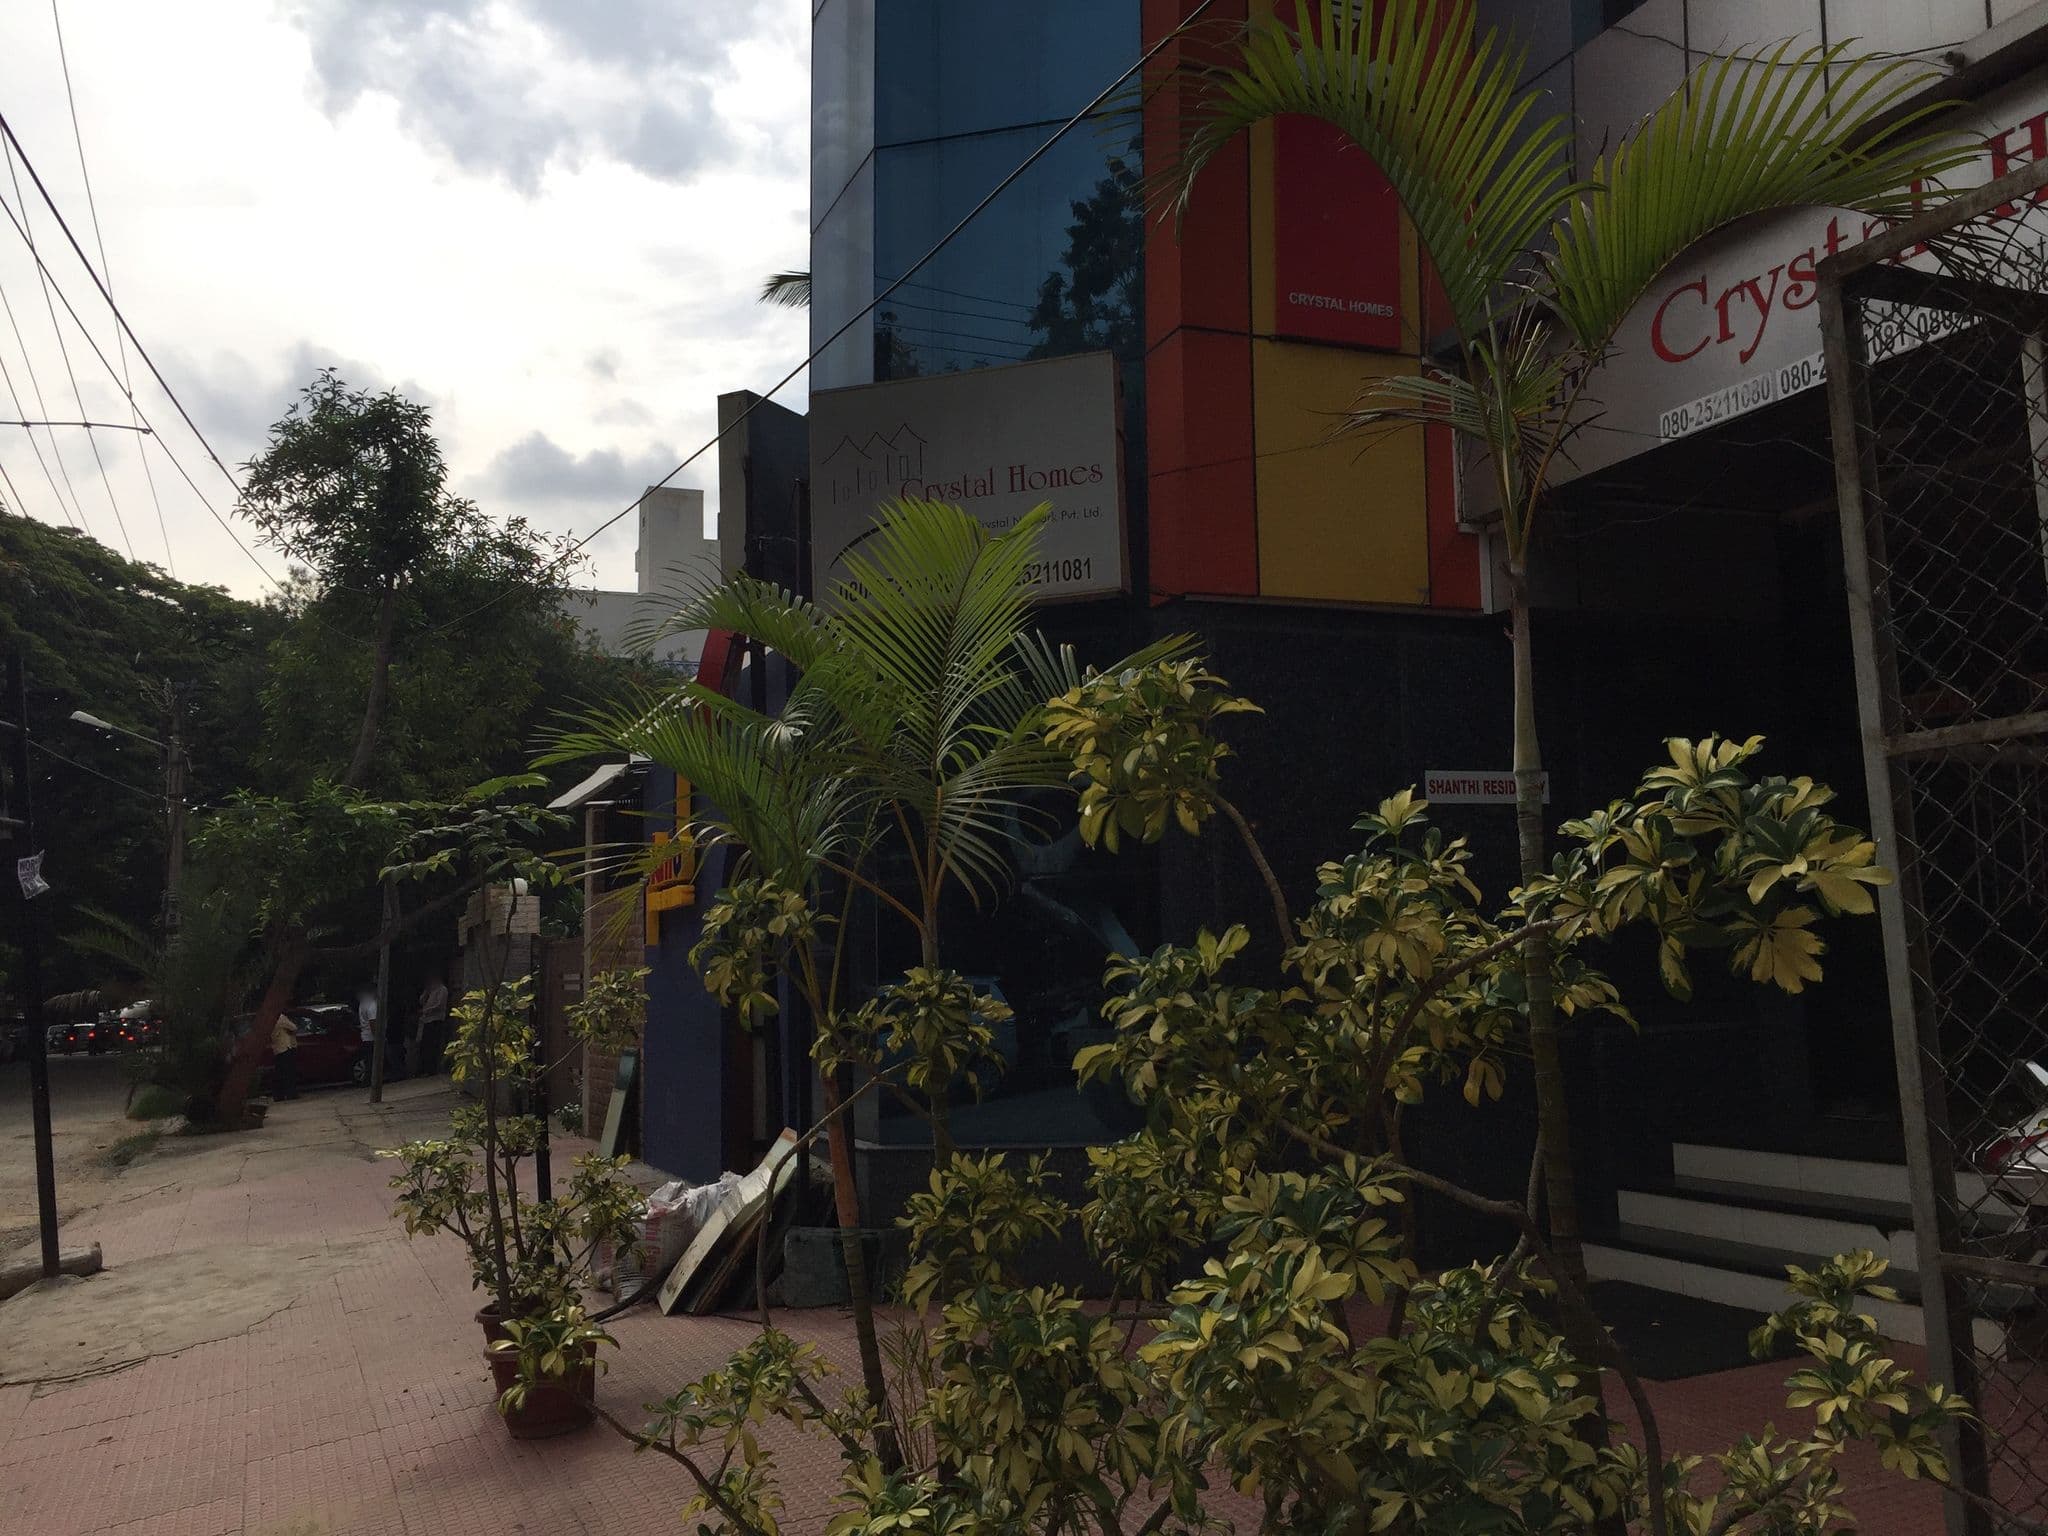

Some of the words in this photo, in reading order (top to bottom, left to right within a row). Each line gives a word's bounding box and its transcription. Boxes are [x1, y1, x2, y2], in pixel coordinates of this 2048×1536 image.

[1288, 292, 1346, 312] CRYSTAL
[1348, 300, 1394, 318] HOMES
[900, 467, 995, 505] Crystal
[1007, 462, 1104, 495] Homes
[1428, 778, 1480, 795] SHANTHI
